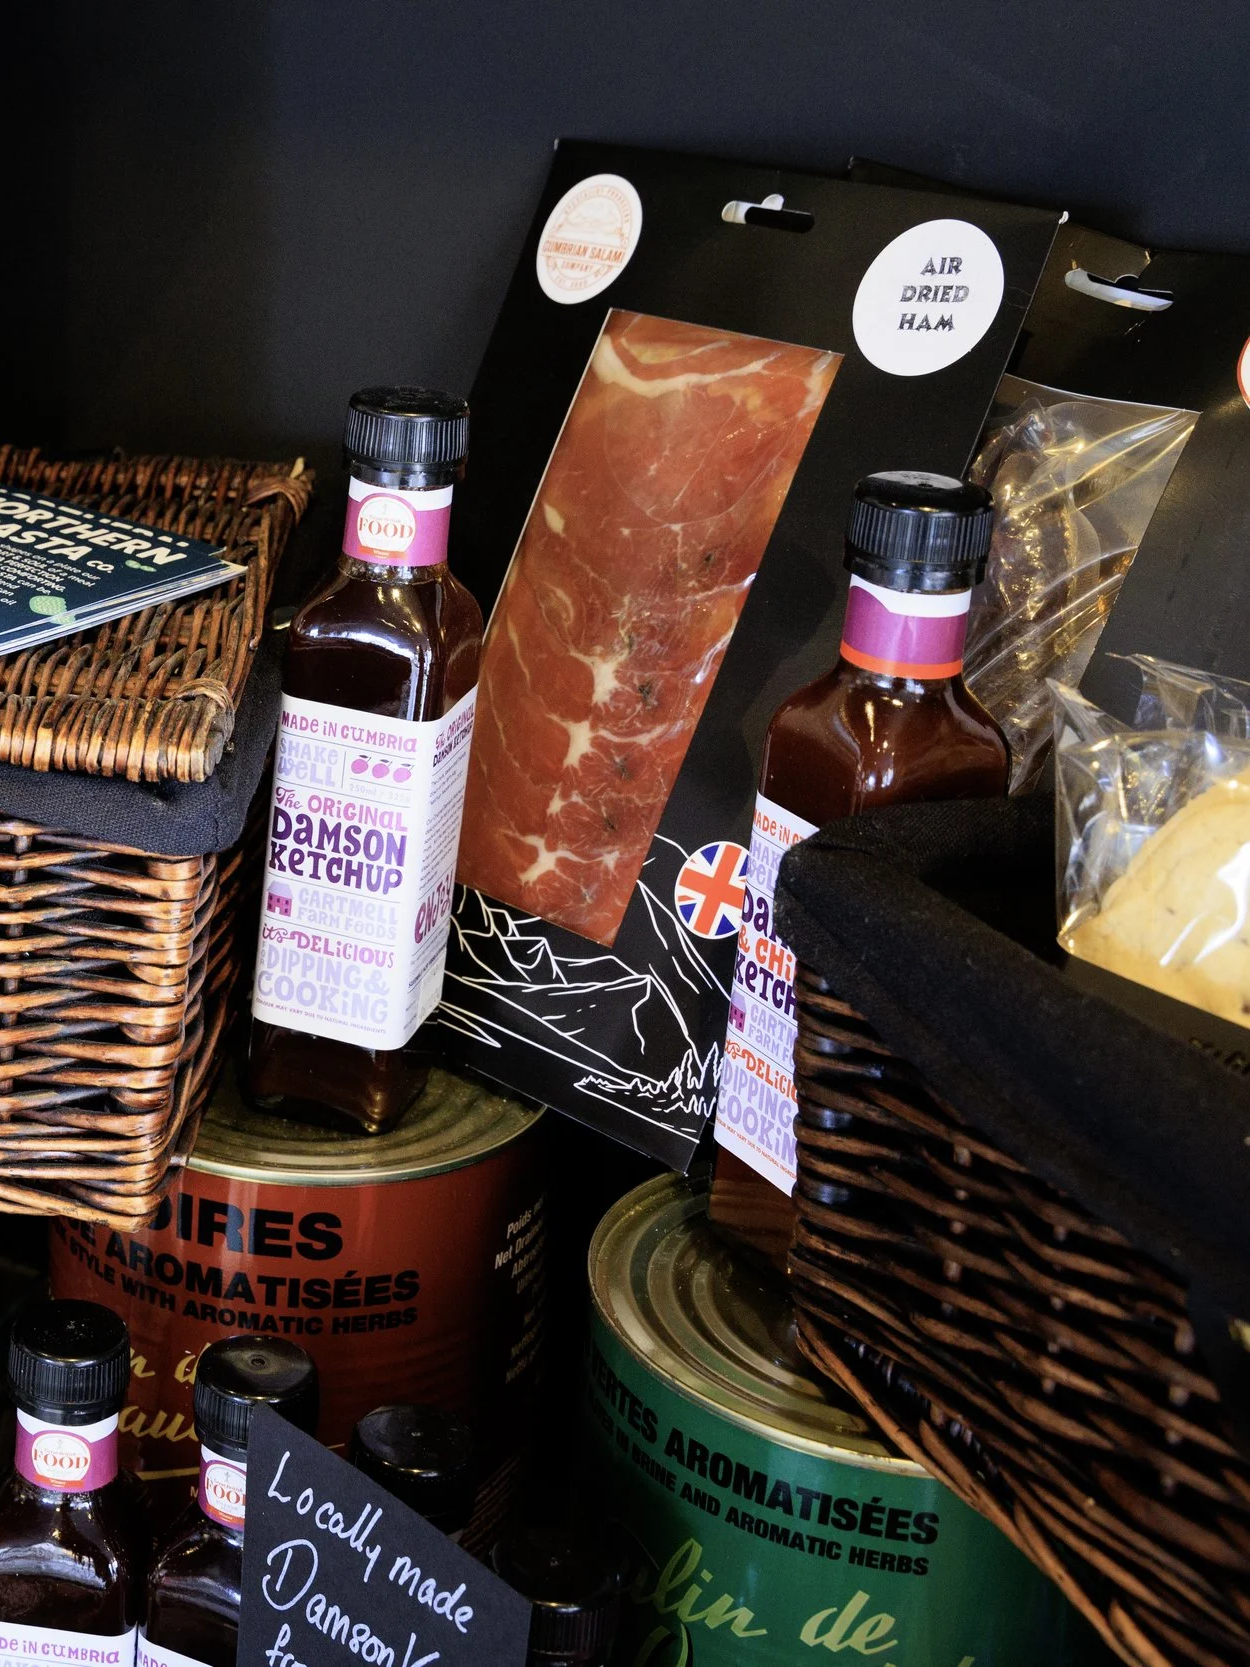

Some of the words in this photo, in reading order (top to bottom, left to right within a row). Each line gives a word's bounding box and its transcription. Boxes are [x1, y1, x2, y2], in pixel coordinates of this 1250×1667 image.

[590, 247, 626, 264] SALAMI
[920, 257, 963, 276] AIR
[899, 285, 970, 303] DRIED
[897, 313, 955, 332] HAM
[359, 517, 413, 539] FOOD
[275, 786, 303, 810] The
[271, 806, 407, 867] DaMSON
[268, 840, 403, 895] KeTCHUP
[344, 917, 398, 940] FOODS
[267, 943, 362, 990] DIPPING
[363, 969, 391, 996] &
[734, 952, 797, 1021] KeTCH
[755, 937, 794, 982] CHi
[257, 970, 388, 1025] COOKiNG
[749, 1003, 798, 1049] CARTM
[717, 1084, 797, 1167] COOKiN
[105, 1231, 421, 1311] AROMATISÉES
[121, 1273, 176, 1312] WITH
[182, 1300, 324, 1336] AROMATIC
[332, 1306, 419, 1336] HERBS
[33, 1448, 89, 1469] FOOD
[631, 1442, 677, 1493] BRINE
[679, 1481, 721, 1517] AND
[724, 1505, 842, 1561] AROMATIC
[849, 1546, 929, 1576] HERBS
[664, 1427, 940, 1546] AROMATISÉES
[267, 1450, 383, 1583] Locally
[388, 1556, 474, 1634] made
[262, 1538, 395, 1667] Damson
[799, 1590, 899, 1655] de
